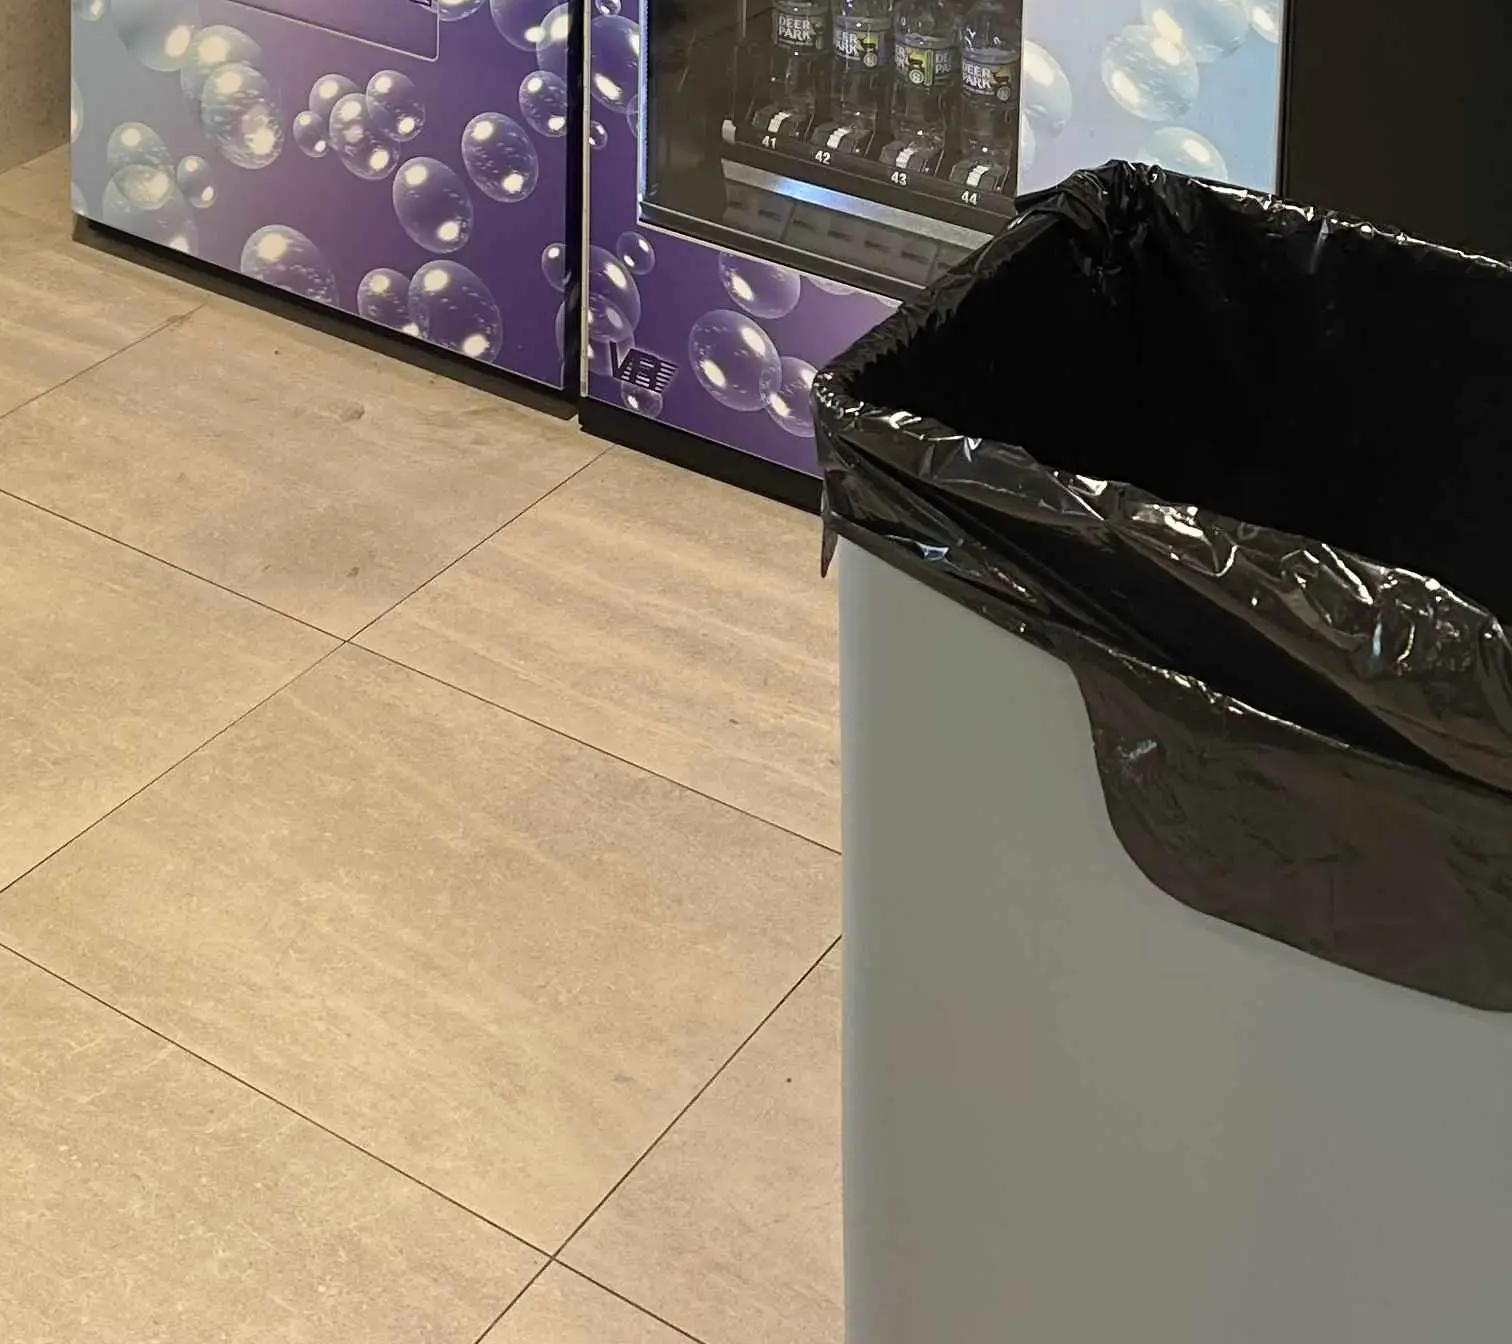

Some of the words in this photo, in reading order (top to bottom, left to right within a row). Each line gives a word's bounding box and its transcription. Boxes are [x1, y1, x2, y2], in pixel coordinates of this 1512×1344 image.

[778, 15, 810, 30] DEER
[778, 26, 811, 41] PARK
[762, 136, 776, 149] 41
[815, 150, 831, 164] 42
[891, 171, 907, 185] 43
[961, 190, 977, 205] 44
